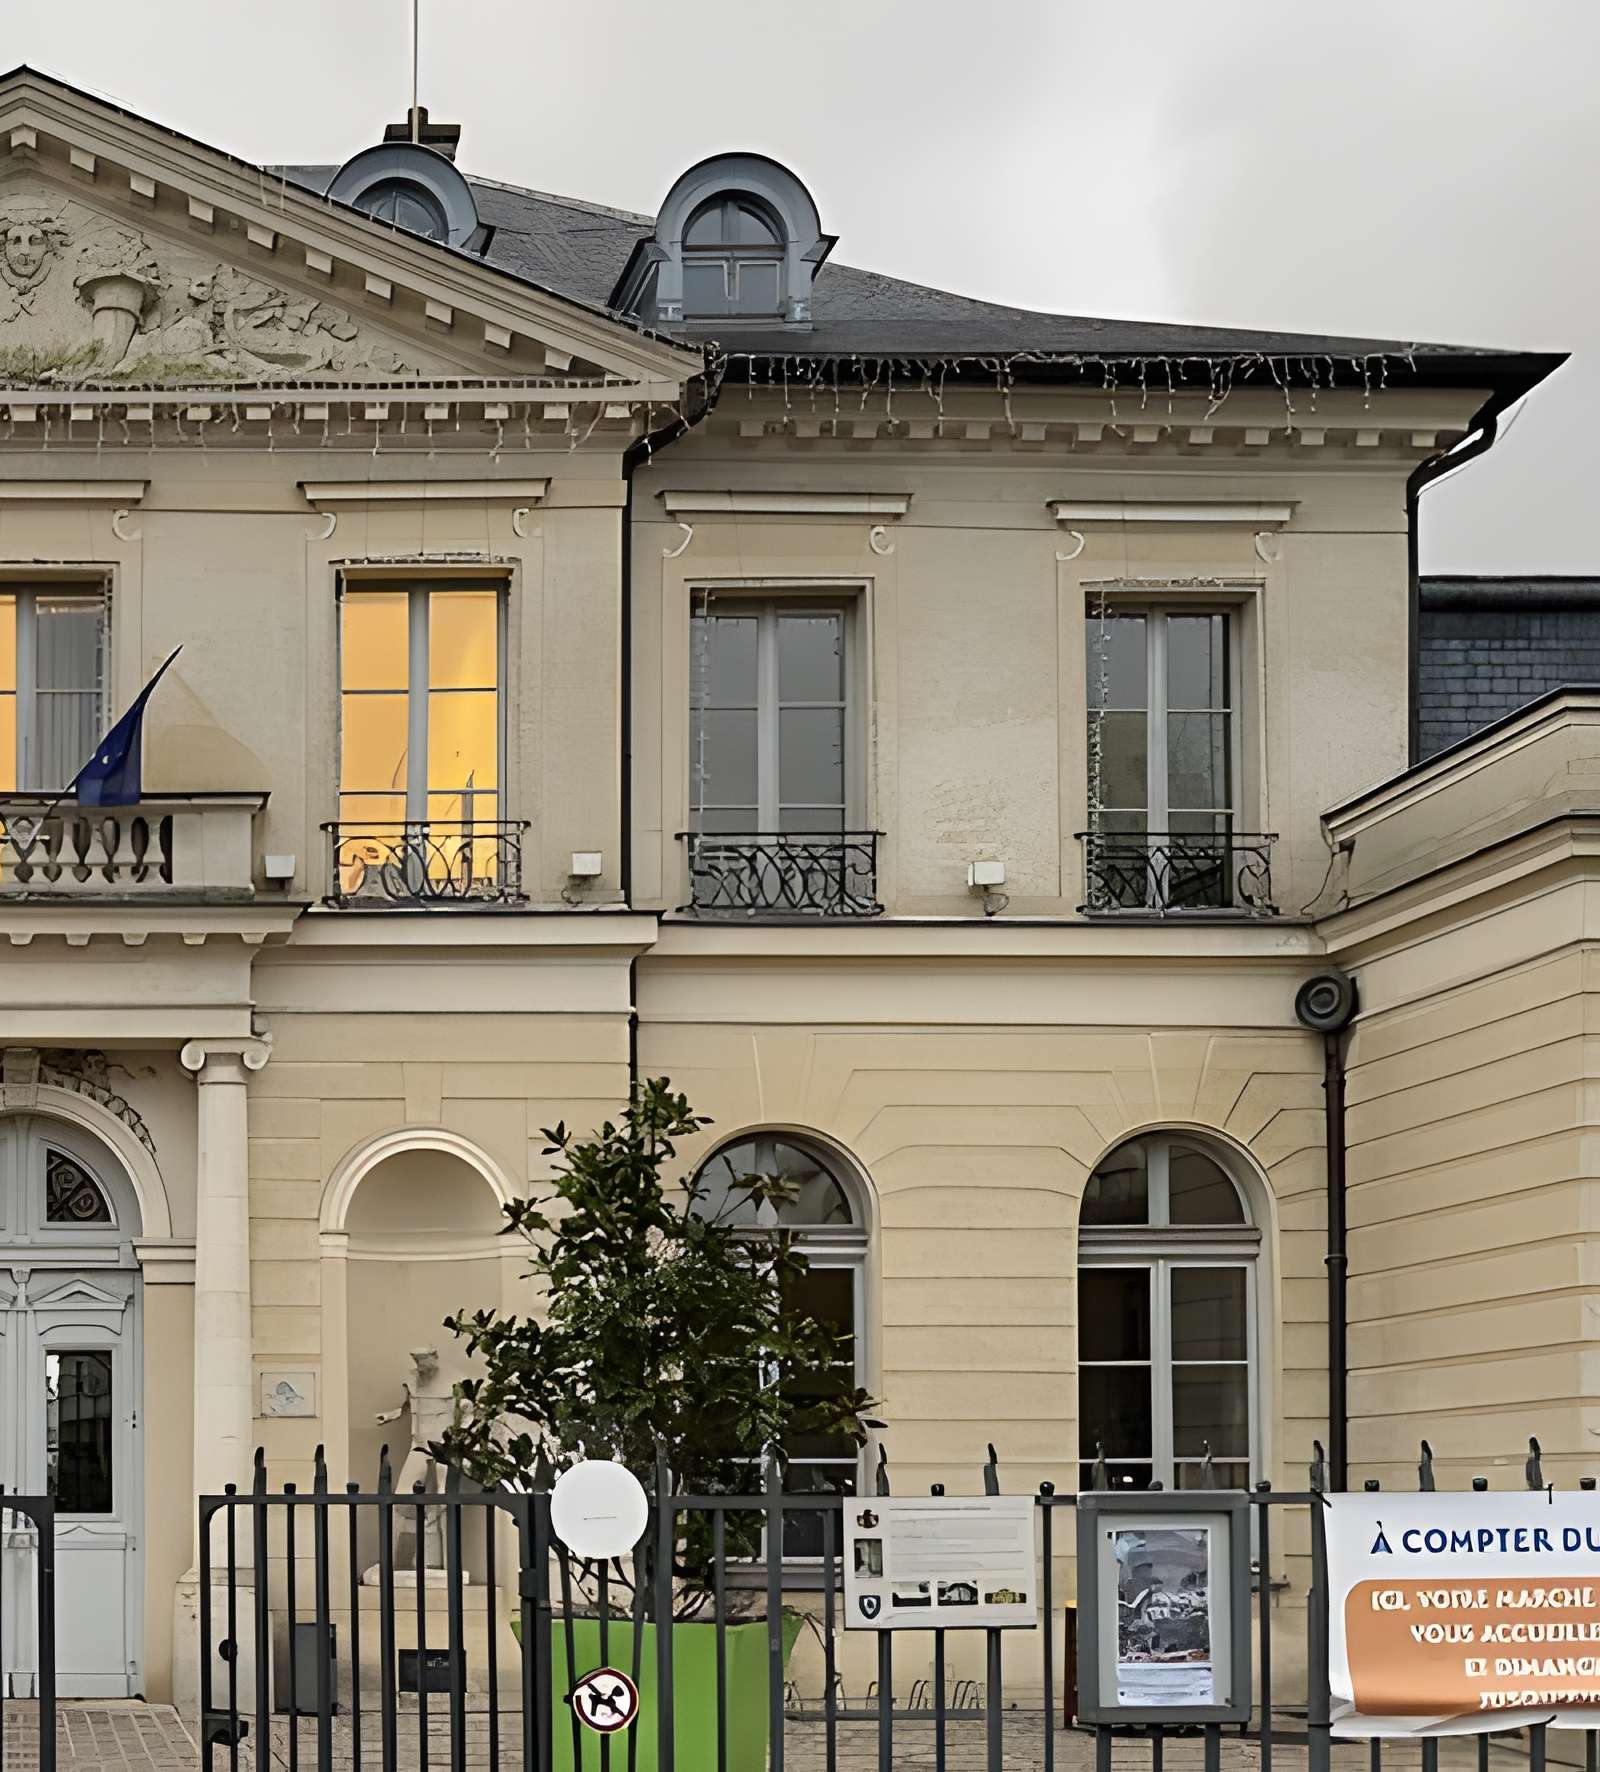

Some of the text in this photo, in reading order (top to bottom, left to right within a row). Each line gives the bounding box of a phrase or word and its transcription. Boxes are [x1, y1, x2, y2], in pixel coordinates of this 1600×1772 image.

[1402, 1528, 1554, 1553] COMPTER
[1561, 1527, 1600, 1552] DU
[1410, 1623, 1475, 1643] VOUS
